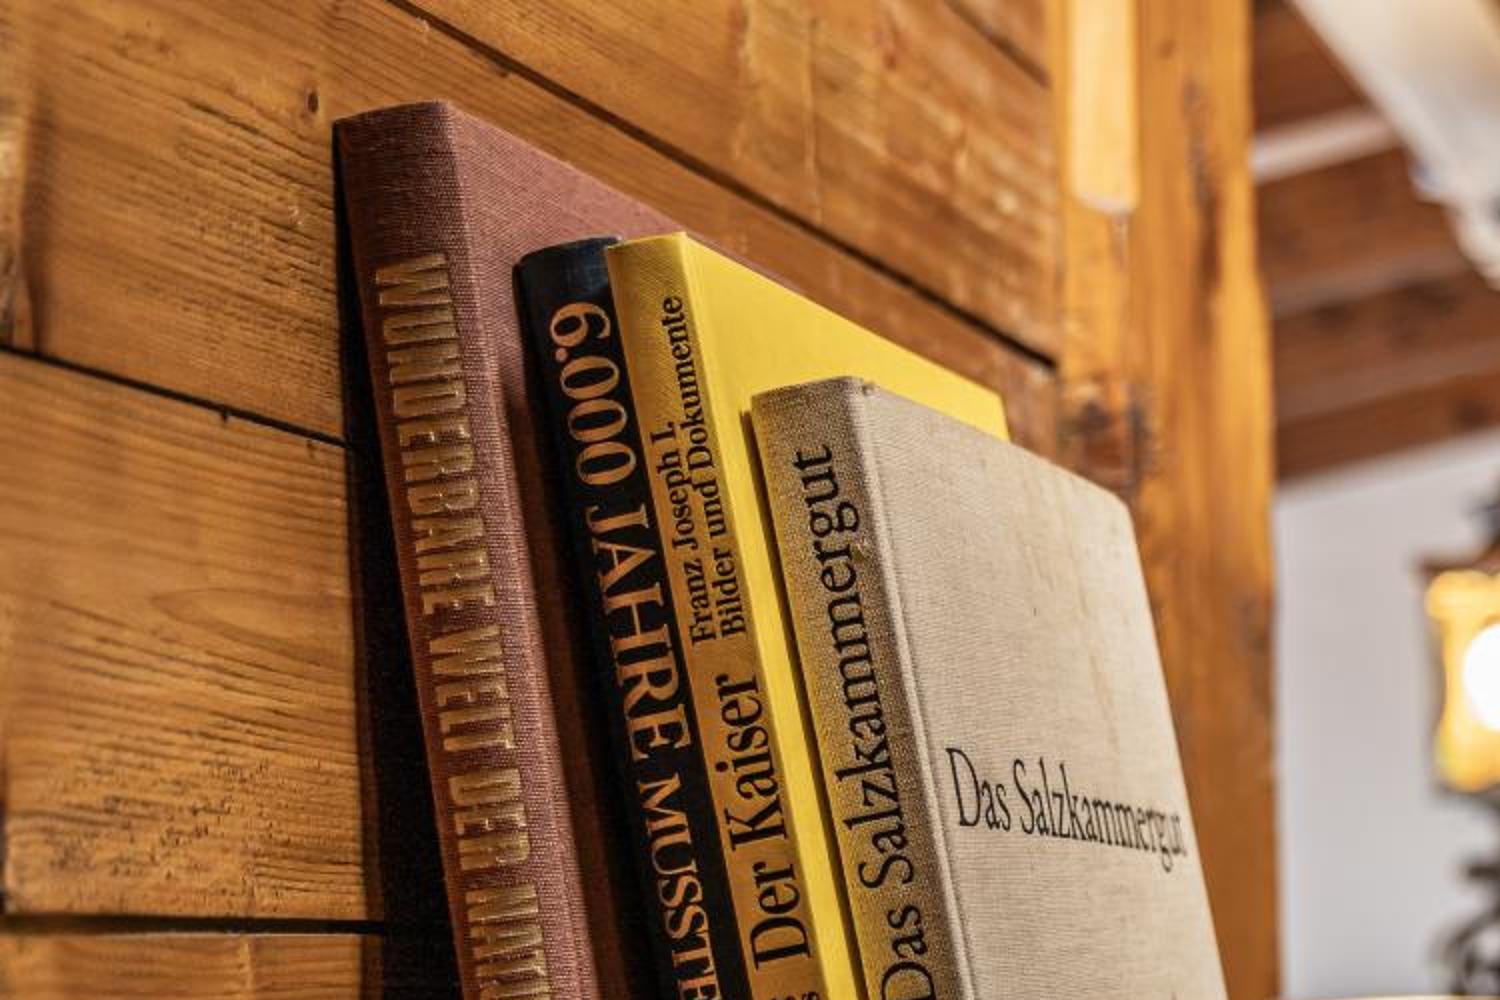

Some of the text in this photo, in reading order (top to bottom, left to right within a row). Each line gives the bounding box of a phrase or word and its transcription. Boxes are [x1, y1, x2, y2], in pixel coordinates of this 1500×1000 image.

[376, 252, 497, 616] WUNDERBARE
[550, 302, 638, 486] 6.000
[661, 296, 746, 642] Bilder und Dokumente
[657, 448, 699, 552] Joseph
[429, 624, 516, 753] WELT
[589, 502, 693, 762] JAHRE
[682, 558, 717, 648] Franz
[795, 443, 914, 890] Salzkammergut
[448, 768, 531, 872] DER
[714, 673, 812, 970] Der Kaiser
[945, 747, 1011, 832] Das
